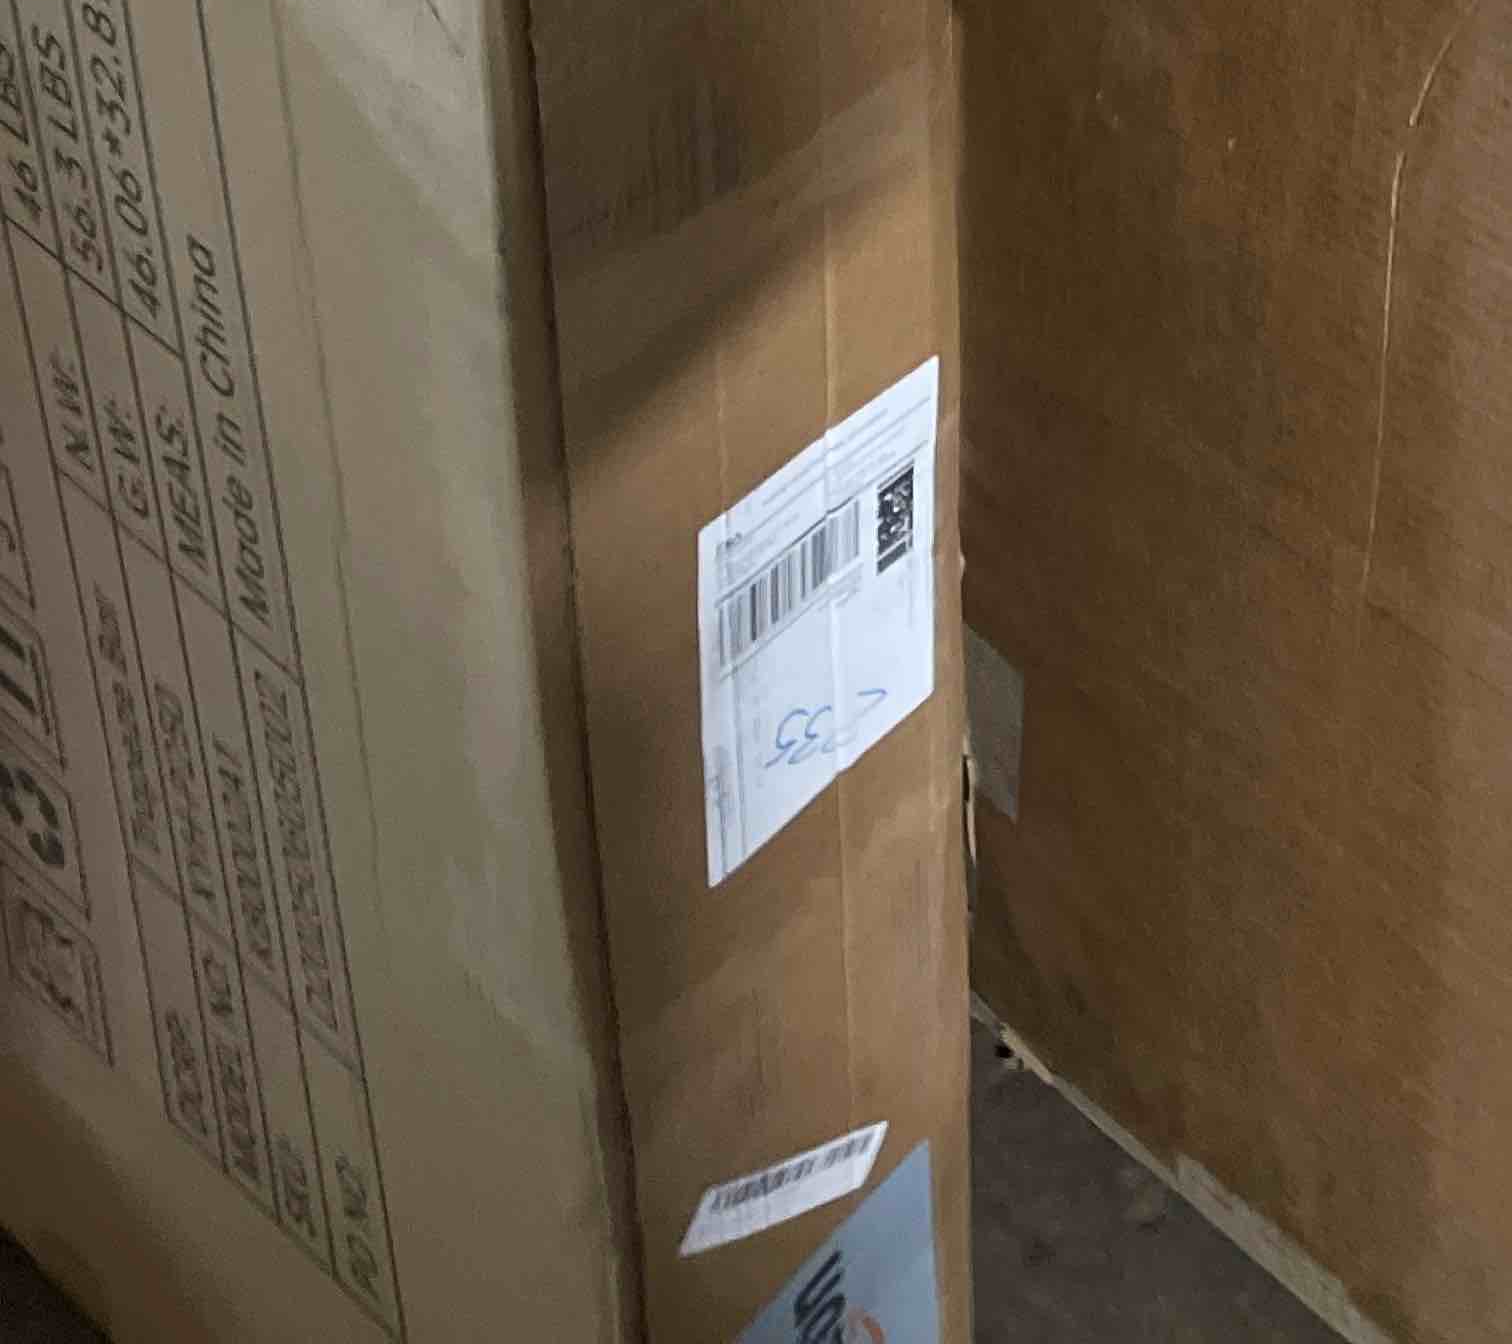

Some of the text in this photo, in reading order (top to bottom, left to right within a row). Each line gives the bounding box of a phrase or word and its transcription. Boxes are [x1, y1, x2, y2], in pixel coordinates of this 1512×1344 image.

[31, 25, 103, 273] 56.3 LBS
[184, 231, 275, 629] Made in China
